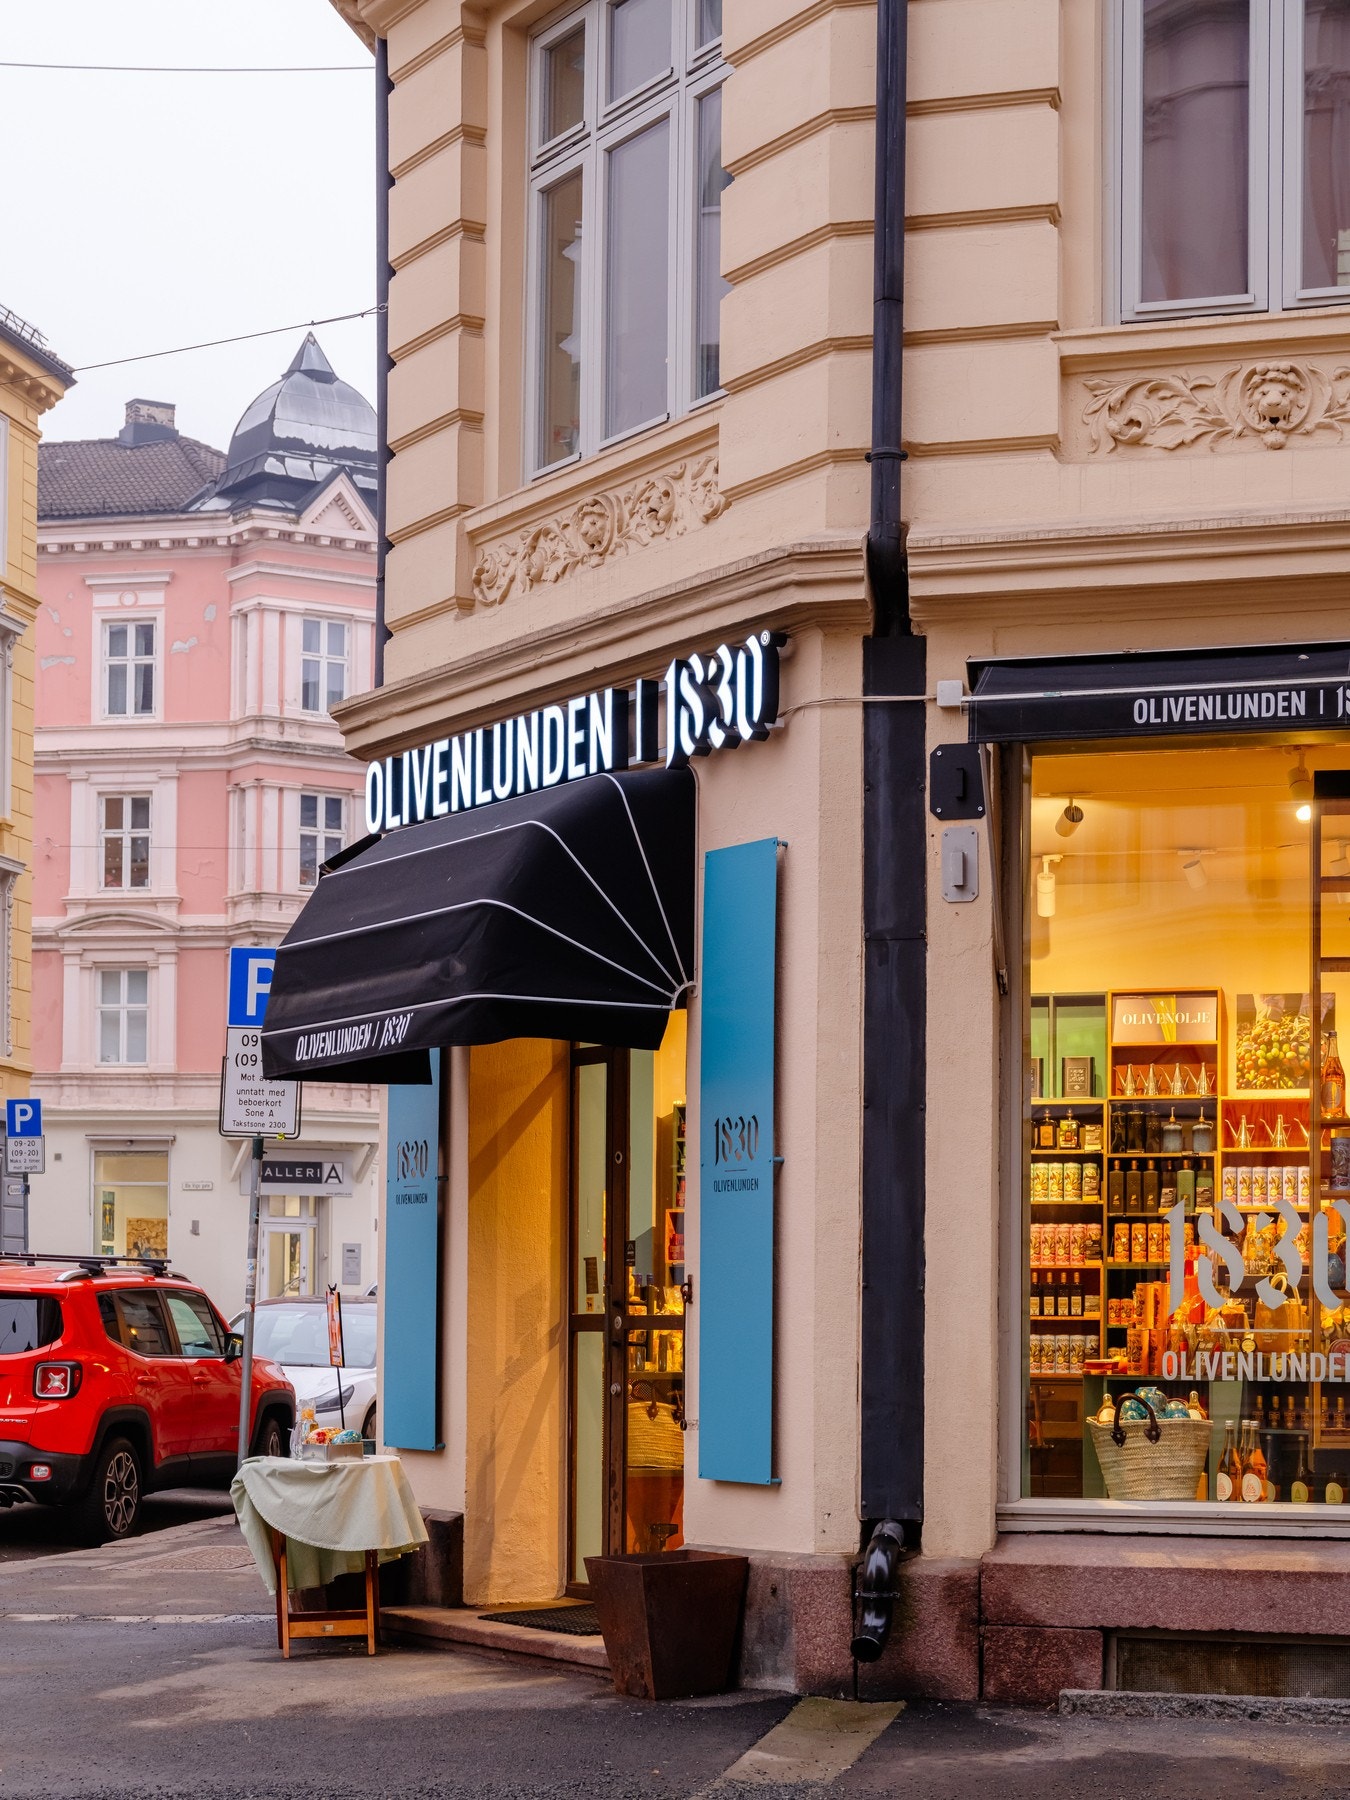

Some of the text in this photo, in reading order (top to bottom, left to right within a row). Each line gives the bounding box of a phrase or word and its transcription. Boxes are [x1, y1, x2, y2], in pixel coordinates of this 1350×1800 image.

[1133, 690, 1306, 724] OLIVENLUNDEN
[365, 687, 613, 835] OLIVENLUNDEN
[246, 958, 275, 1016] P
[1122, 1012, 1211, 1025] OLIVENOLJE
[295, 1022, 373, 1061] OLIVENLUNDEN
[236, 1088, 285, 1097] unntatt med
[238, 1098, 282, 1107] beboerkort
[15, 1103, 34, 1133] P
[232, 1120, 287, 1129] Takstsone 2300
[245, 1108, 274, 1117] Sone A
[11, 1149, 39, 1157] (09-20)
[713, 1114, 759, 1167] 1830
[397, 1139, 429, 1182] 1830
[261, 1163, 343, 1184] ALLERI A
[713, 1178, 759, 1193] OLIVENLUNDEN
[1163, 1199, 1350, 1316] 1830
